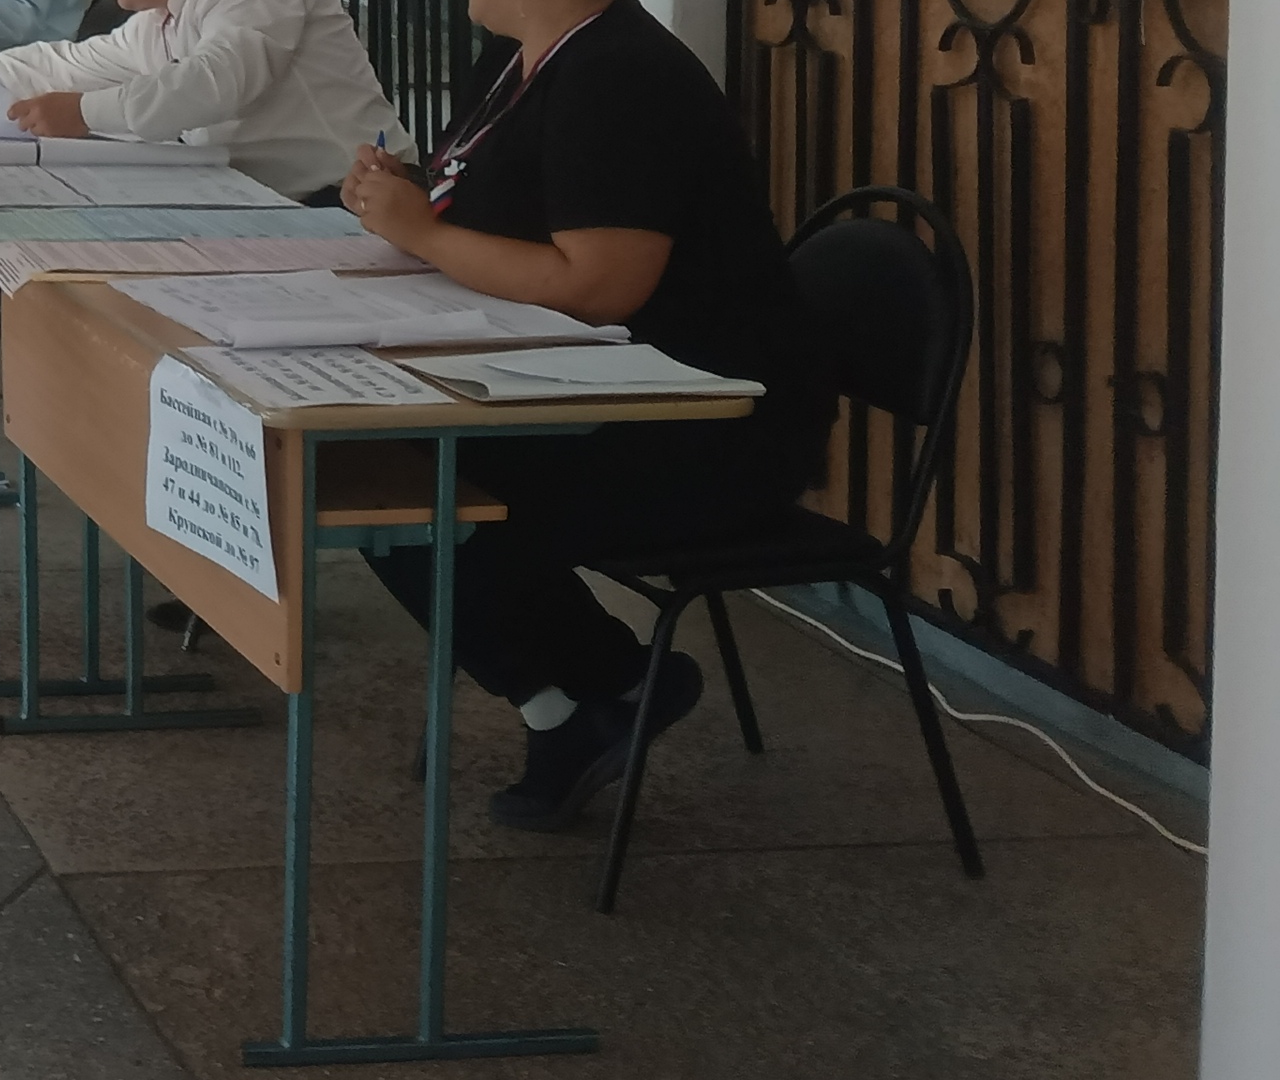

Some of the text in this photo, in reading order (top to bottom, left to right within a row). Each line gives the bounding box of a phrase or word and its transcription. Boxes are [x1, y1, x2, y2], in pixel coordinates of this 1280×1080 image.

[160, 387, 212, 428] Бассейная
[181, 430, 193, 446] до
[195, 432, 207, 454] №
[163, 476, 175, 494] 47
[179, 486, 186, 501] и
[188, 489, 200, 508] 44
[203, 499, 215, 516] до
[218, 502, 229, 524] №
[242, 524, 249, 539] и
[169, 506, 222, 549] Крупской
[224, 540, 236, 558] до
[237, 544, 248, 567] №
